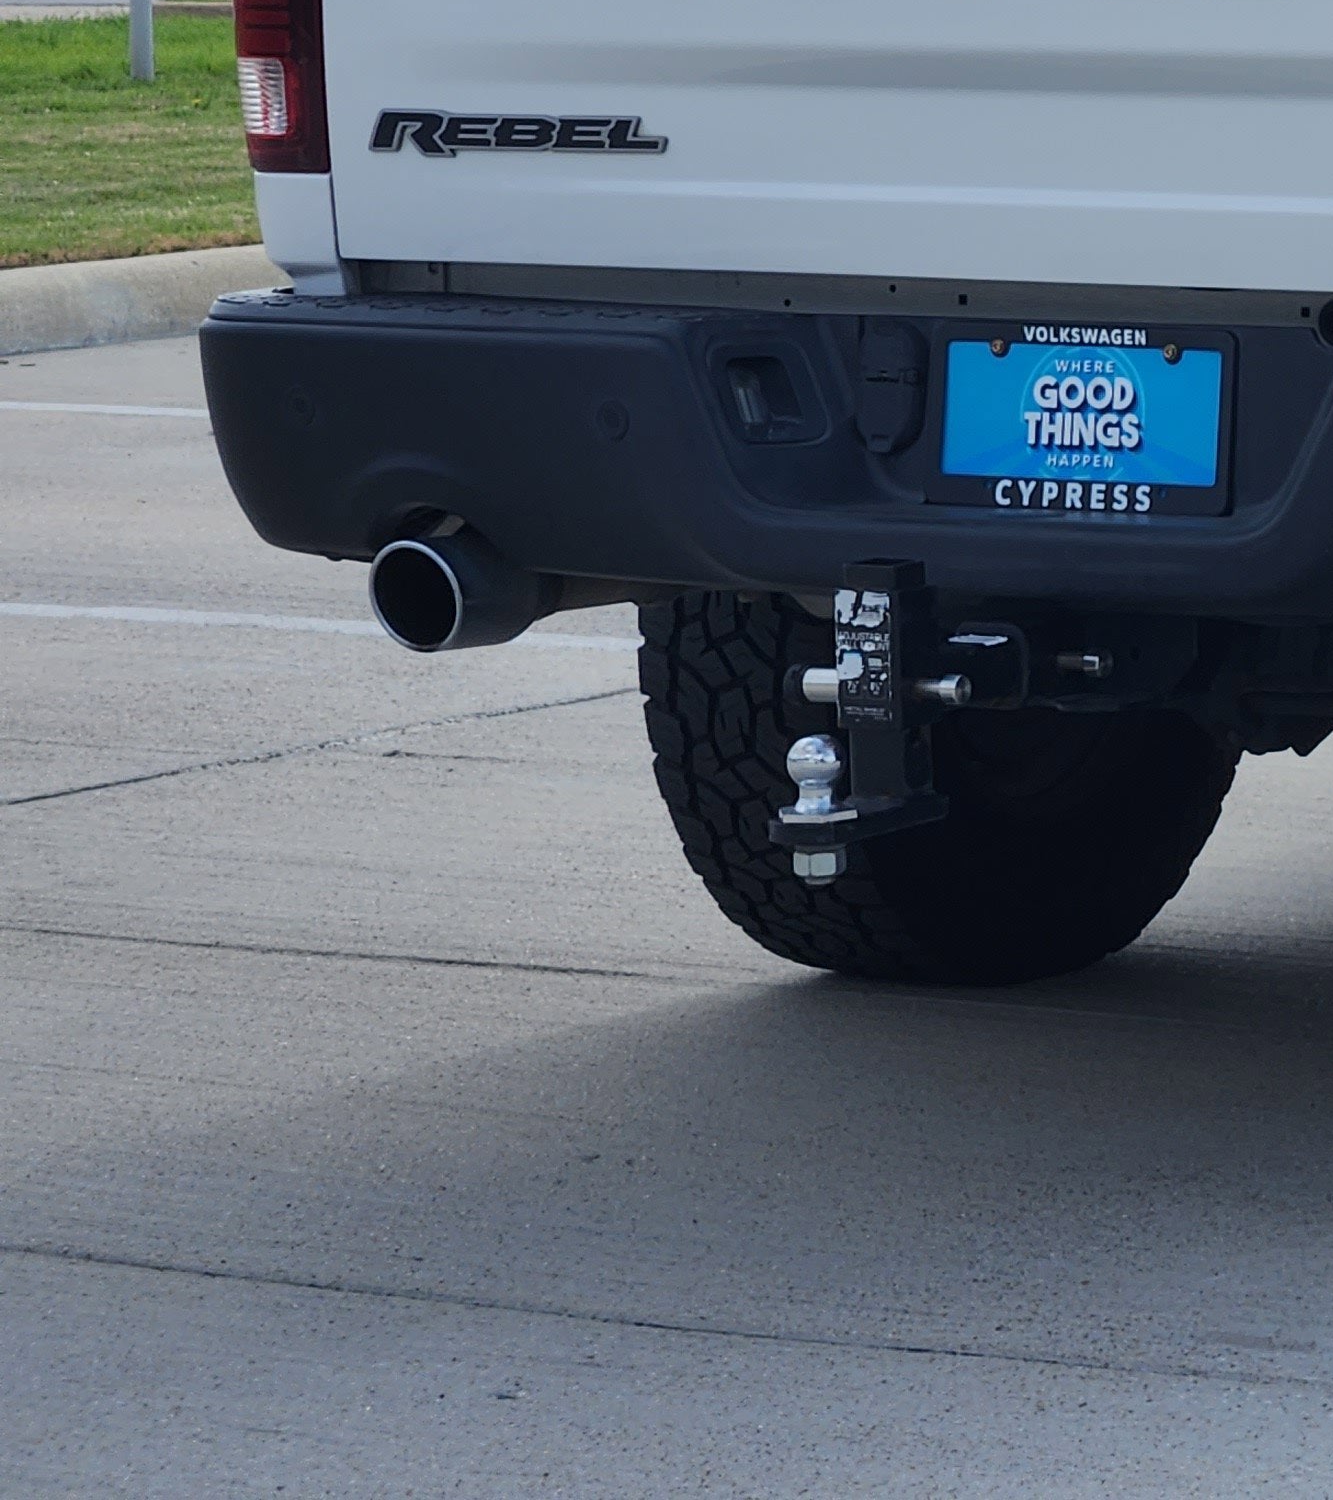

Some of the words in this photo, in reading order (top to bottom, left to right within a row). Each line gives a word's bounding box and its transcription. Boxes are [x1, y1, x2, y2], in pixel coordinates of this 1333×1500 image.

[368, 108, 669, 158] REBEL
[1023, 325, 1148, 346] VOLKSWAGEN
[1054, 359, 1116, 374] WHERE
[1032, 375, 1135, 411] GOOD
[1023, 411, 1142, 449] THINGS
[1046, 453, 1115, 468] HAPPEN
[995, 479, 1152, 512] CYPRESS
